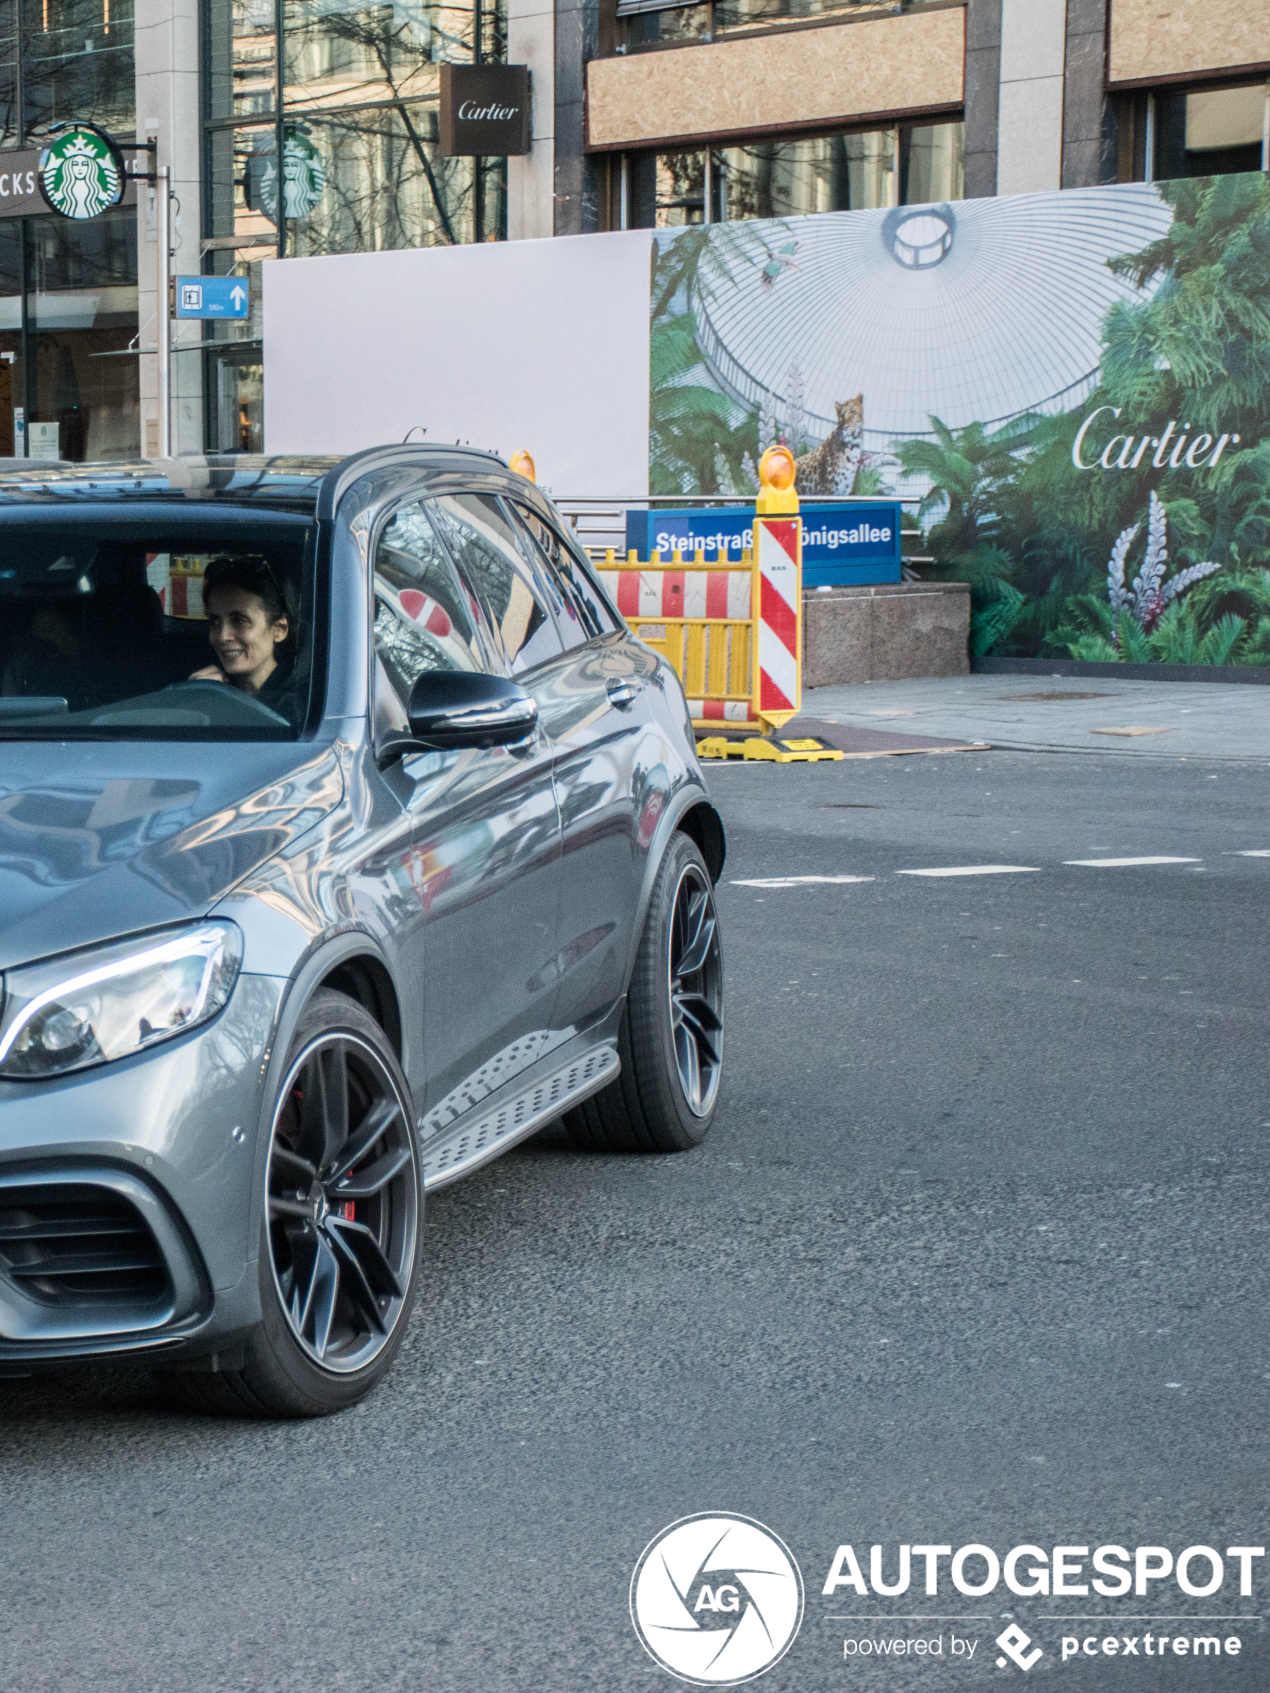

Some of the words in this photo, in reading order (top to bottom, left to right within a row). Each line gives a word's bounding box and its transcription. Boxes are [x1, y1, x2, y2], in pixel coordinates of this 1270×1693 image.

[458, 101, 519, 120] Cartier
[1071, 405, 1241, 470] Cartier
[655, 528, 754, 554] Steinstraß
[801, 522, 892, 549] önigsallee
